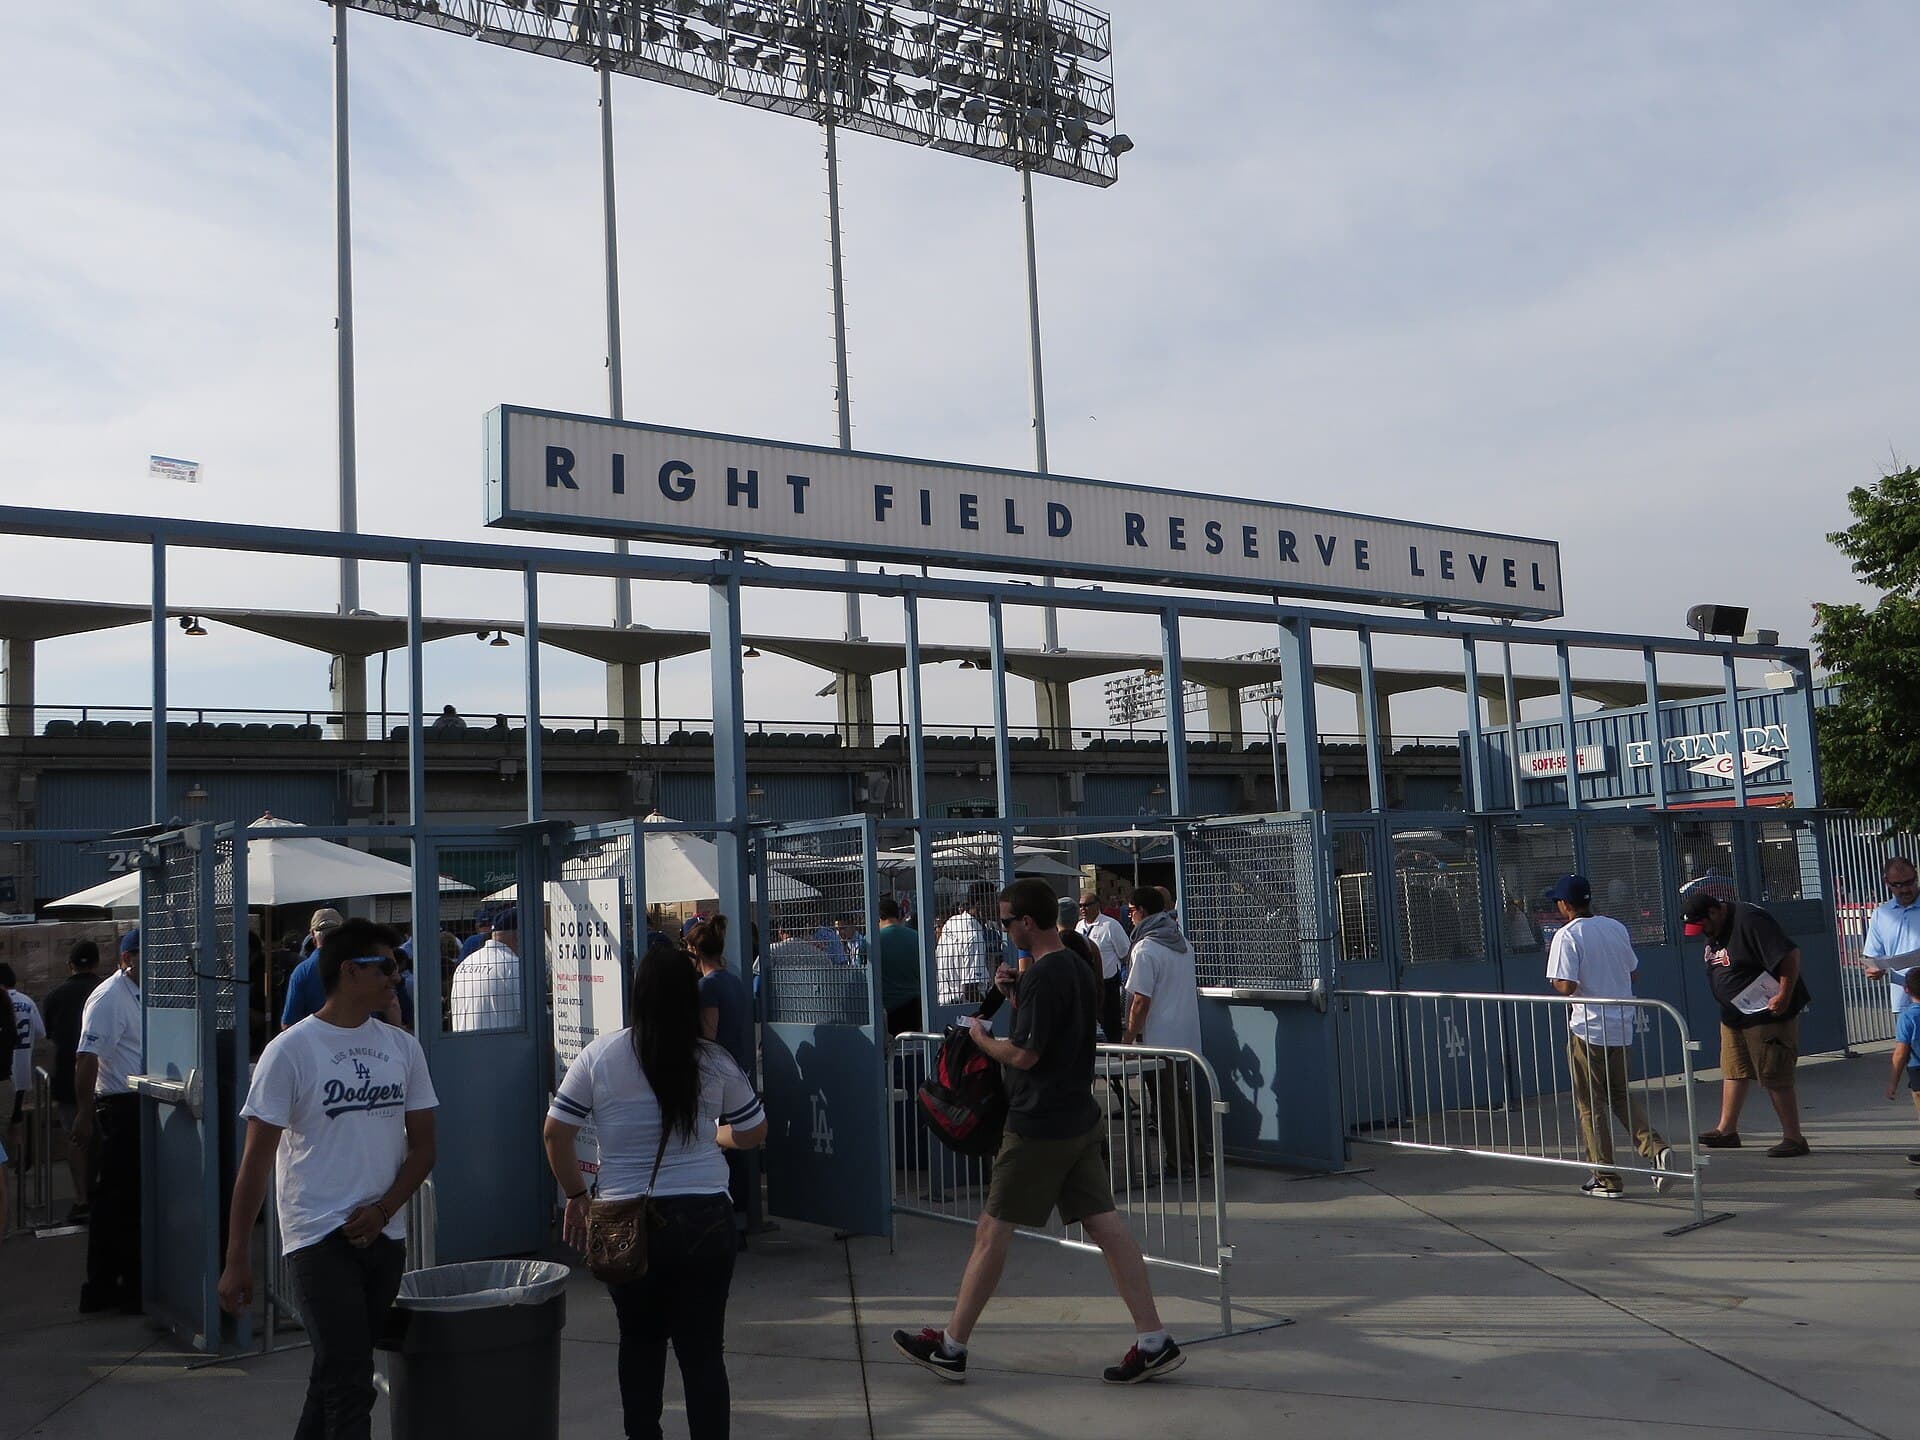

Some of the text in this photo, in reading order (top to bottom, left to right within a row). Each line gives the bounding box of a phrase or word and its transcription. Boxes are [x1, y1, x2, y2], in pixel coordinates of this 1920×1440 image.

[545, 444, 1546, 592] RIGHT FIELD RESERVE LEVEL
[1743, 724, 1789, 752] PA
[1532, 754, 1585, 772] SOFT-SEE
[560, 921, 609, 938] DODGER
[558, 943, 613, 961] STADIUM
[352, 1058, 371, 1079] LA
[322, 1079, 404, 1111] Dodgers
[810, 1095, 834, 1154] LA
